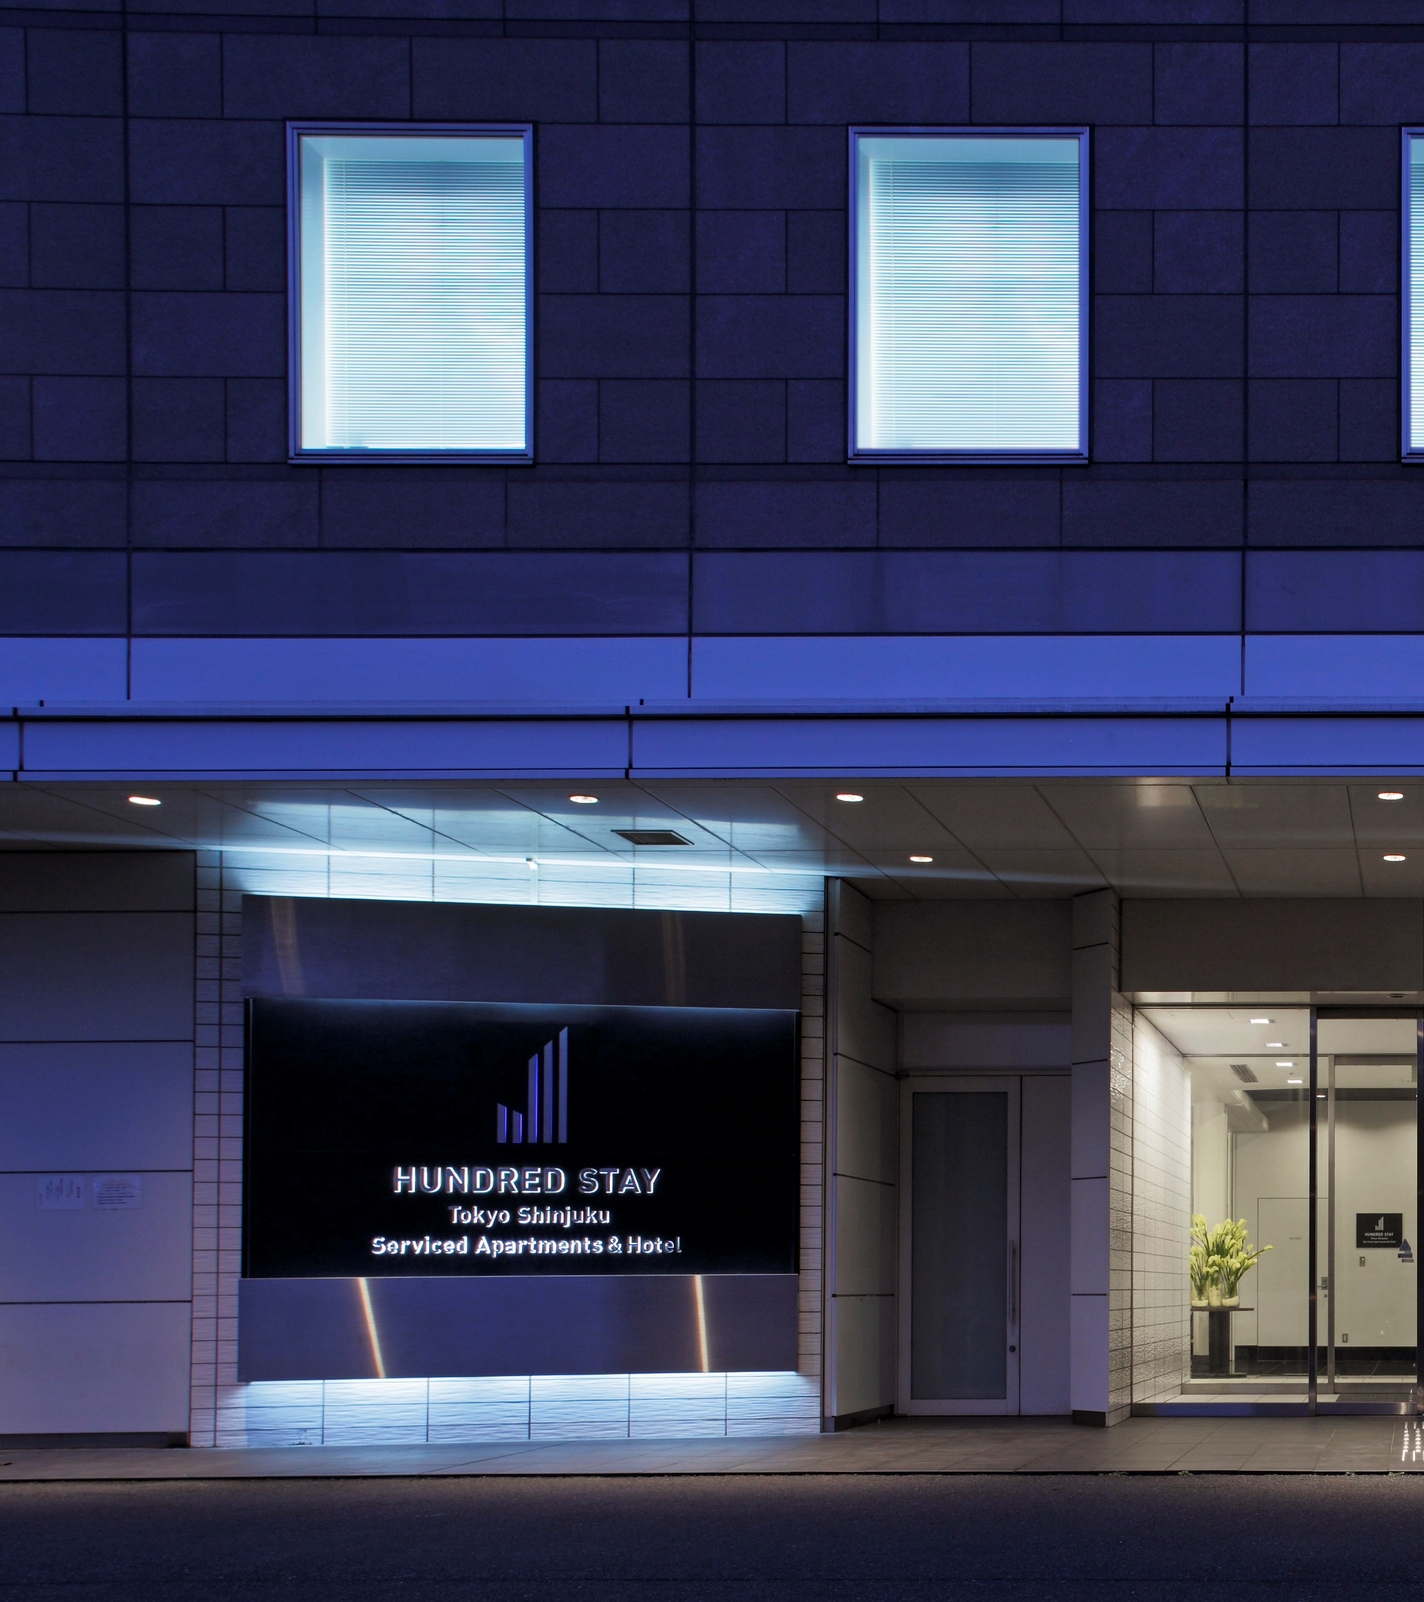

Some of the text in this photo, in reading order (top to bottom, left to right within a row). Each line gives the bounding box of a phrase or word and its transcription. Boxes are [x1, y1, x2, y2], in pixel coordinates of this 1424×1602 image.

[393, 1166, 661, 1194] HUNDRED STAY
[449, 1205, 610, 1228] Tokyo Shinjuku
[372, 1236, 682, 1258] Serviced Apartments & Hotel
